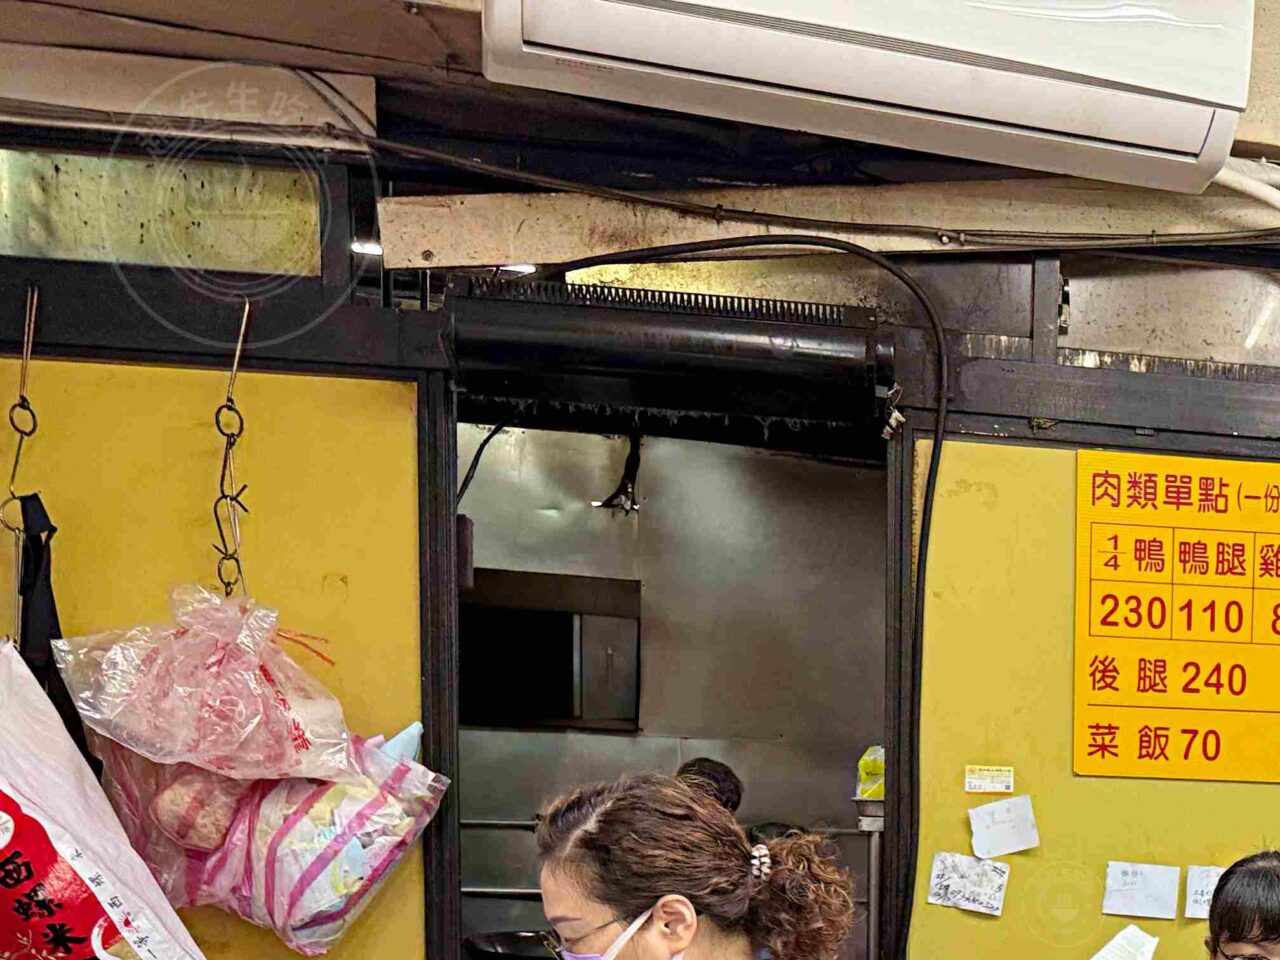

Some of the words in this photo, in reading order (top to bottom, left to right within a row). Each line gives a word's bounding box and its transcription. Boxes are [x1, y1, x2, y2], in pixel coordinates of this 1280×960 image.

[1177, 539, 1246, 576] 鴨腿
[1099, 593, 1167, 630] 230
[1178, 598, 1244, 634] 110
[1088, 655, 1168, 694] 後腿
[1180, 660, 1247, 697] 240
[1087, 722, 1170, 762] 菜飯
[1179, 728, 1222, 763] 70
